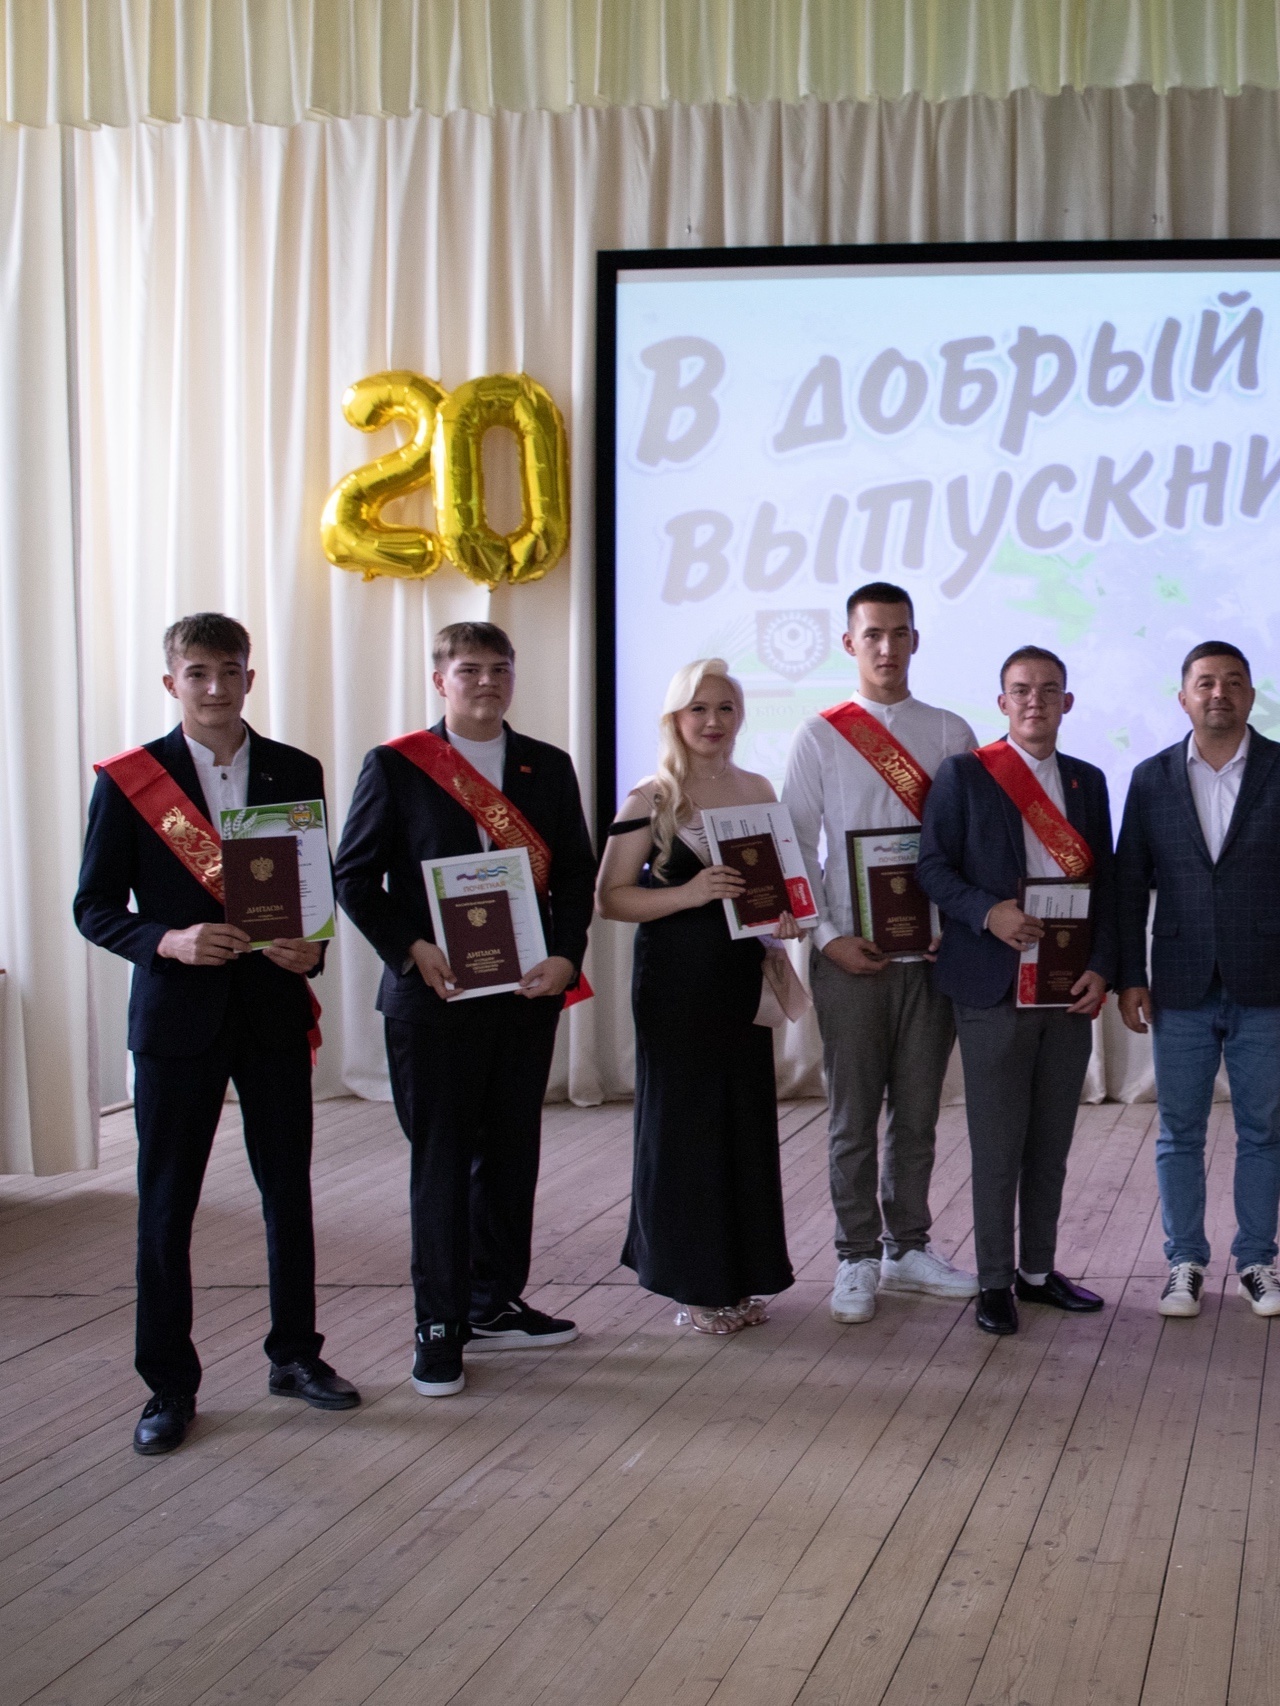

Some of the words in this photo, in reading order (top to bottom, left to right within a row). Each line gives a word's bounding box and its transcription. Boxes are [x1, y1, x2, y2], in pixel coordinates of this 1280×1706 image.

[632, 334, 725, 466] В
[321, 370, 569, 588] 20
[466, 949, 501, 959] ДИПЛОМ
